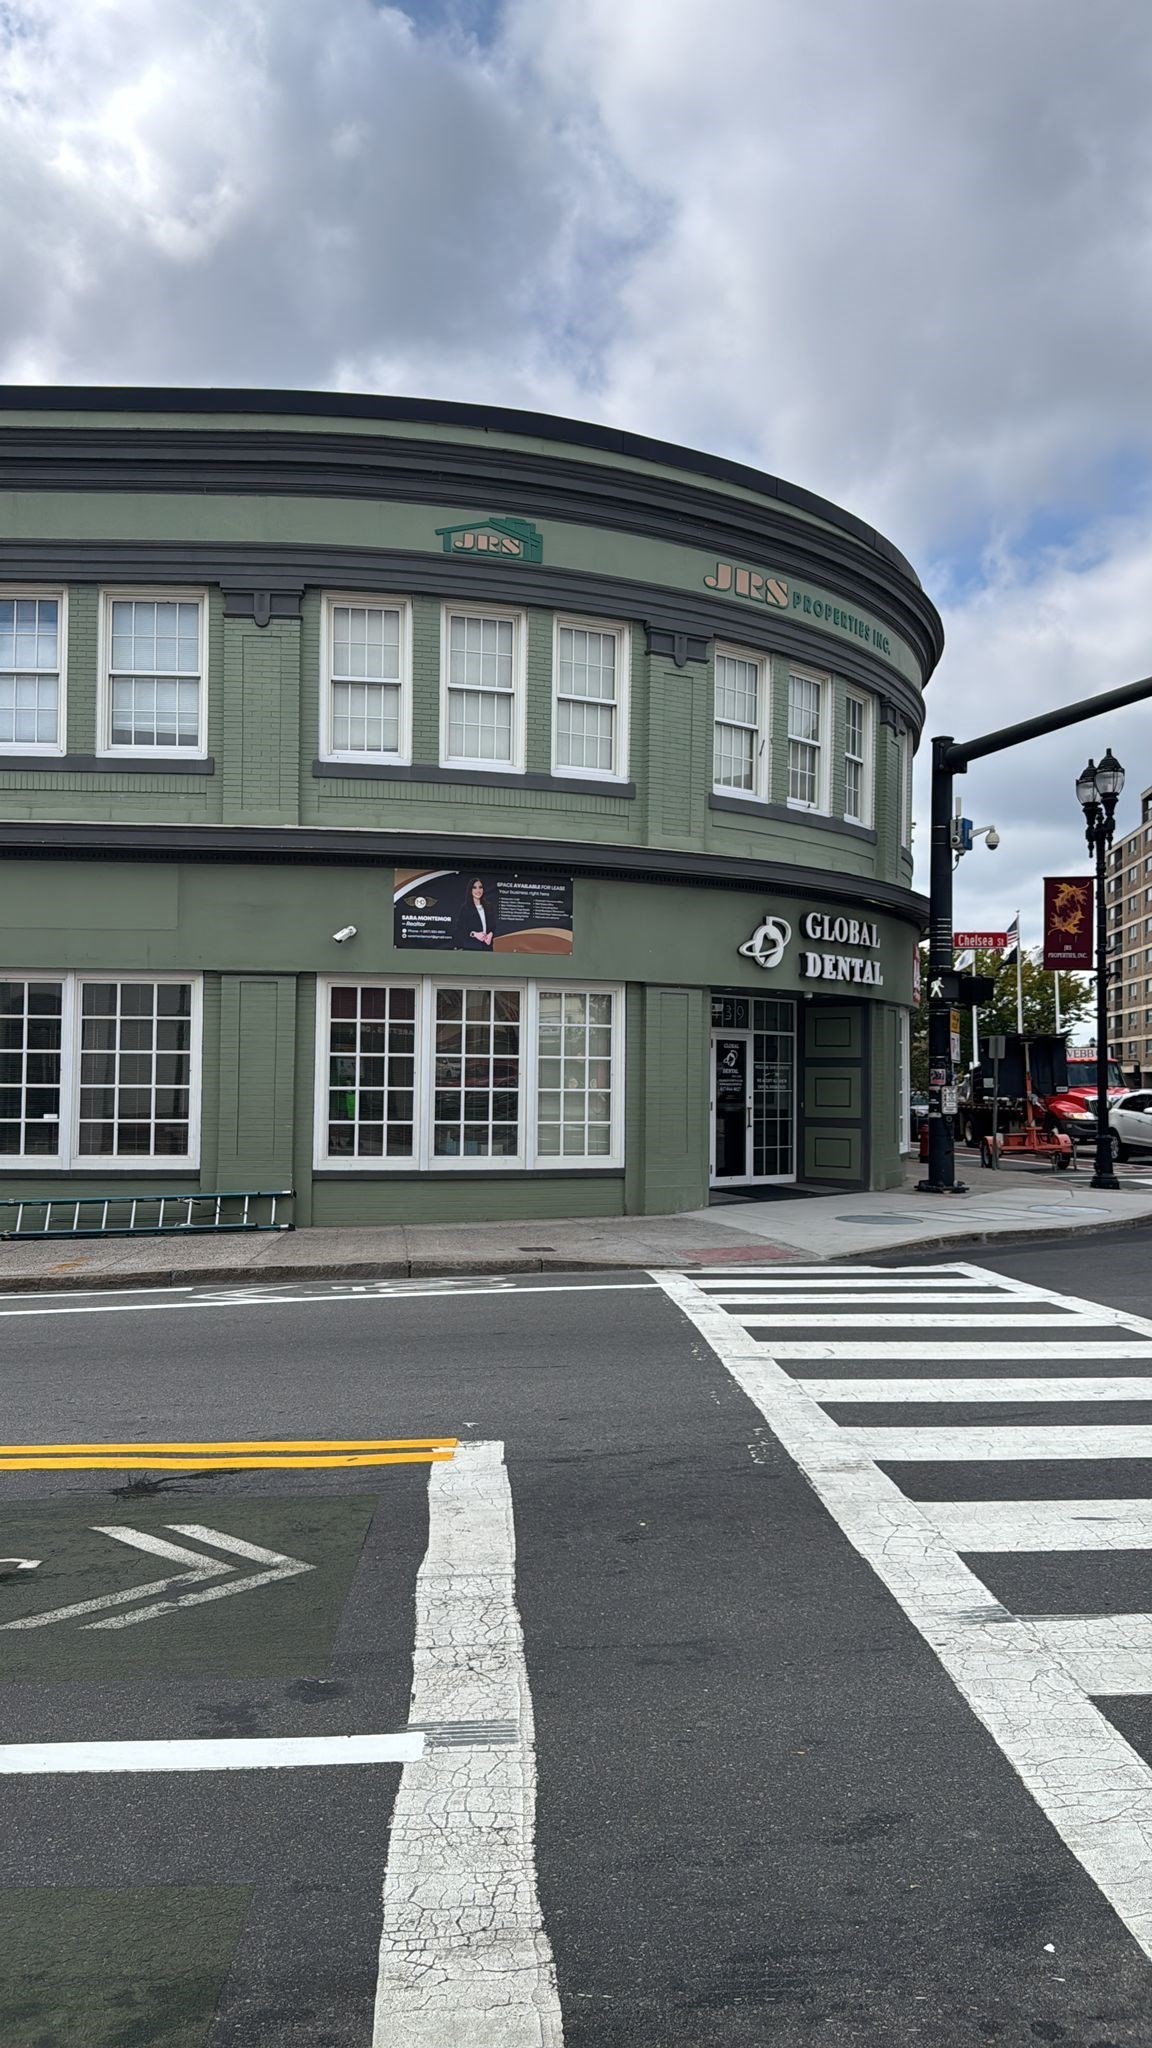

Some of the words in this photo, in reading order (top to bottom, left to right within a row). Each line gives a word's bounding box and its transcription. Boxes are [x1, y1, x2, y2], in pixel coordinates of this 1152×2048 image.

[453, 532, 521, 556] JRS
[703, 562, 790, 609] JRS
[792, 591, 870, 642] PROPERTIES
[872, 629, 891, 656] INC.
[805, 912, 881, 949] GLOBAL
[958, 934, 994, 947] Chelsea
[996, 937, 1004, 946] St
[805, 951, 884, 986] DENTAL
